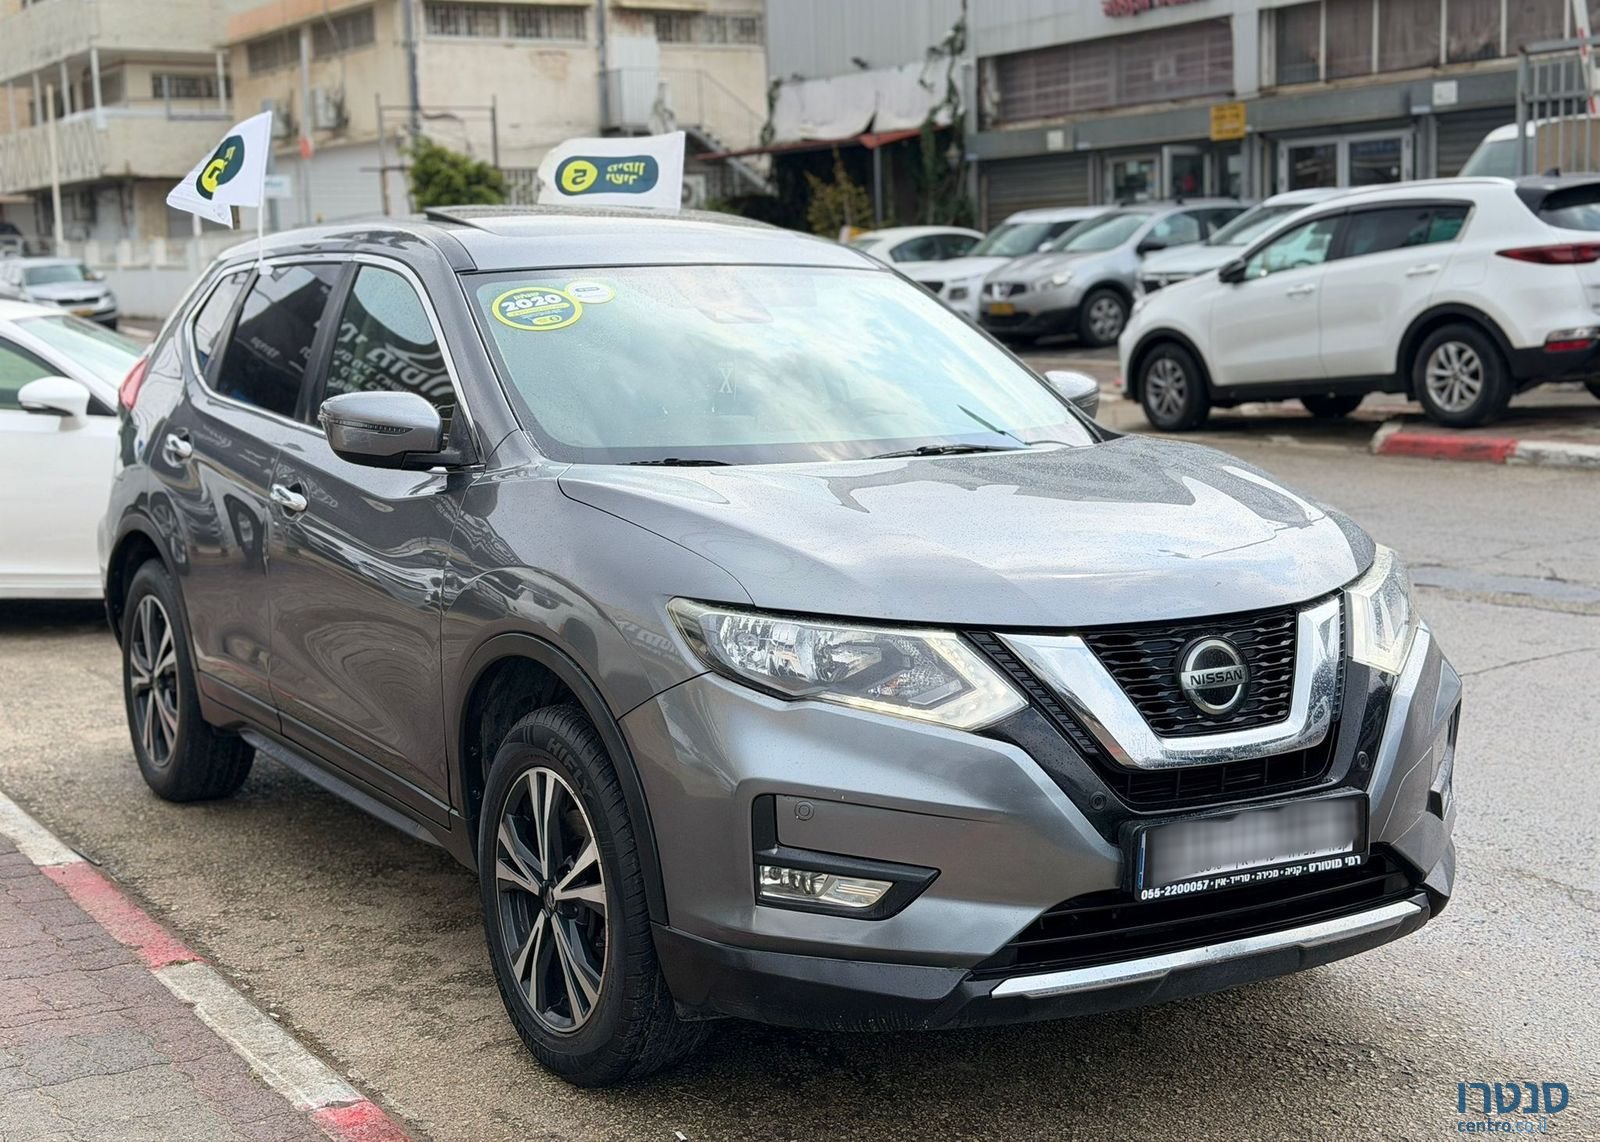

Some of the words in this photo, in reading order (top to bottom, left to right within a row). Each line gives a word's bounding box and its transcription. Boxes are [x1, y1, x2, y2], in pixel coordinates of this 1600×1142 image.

[501, 294, 562, 312] 2020
[1190, 670, 1242, 685] NISSAN
[1308, 857, 1343, 873] מוטורס
[1345, 855, 1361, 866] רמי
[1256, 868, 1279, 881] מכירה
[1285, 865, 1302, 877] קניה
[1214, 872, 1250, 889] טרייד-אין
[1141, 879, 1209, 901] 055-2200057
